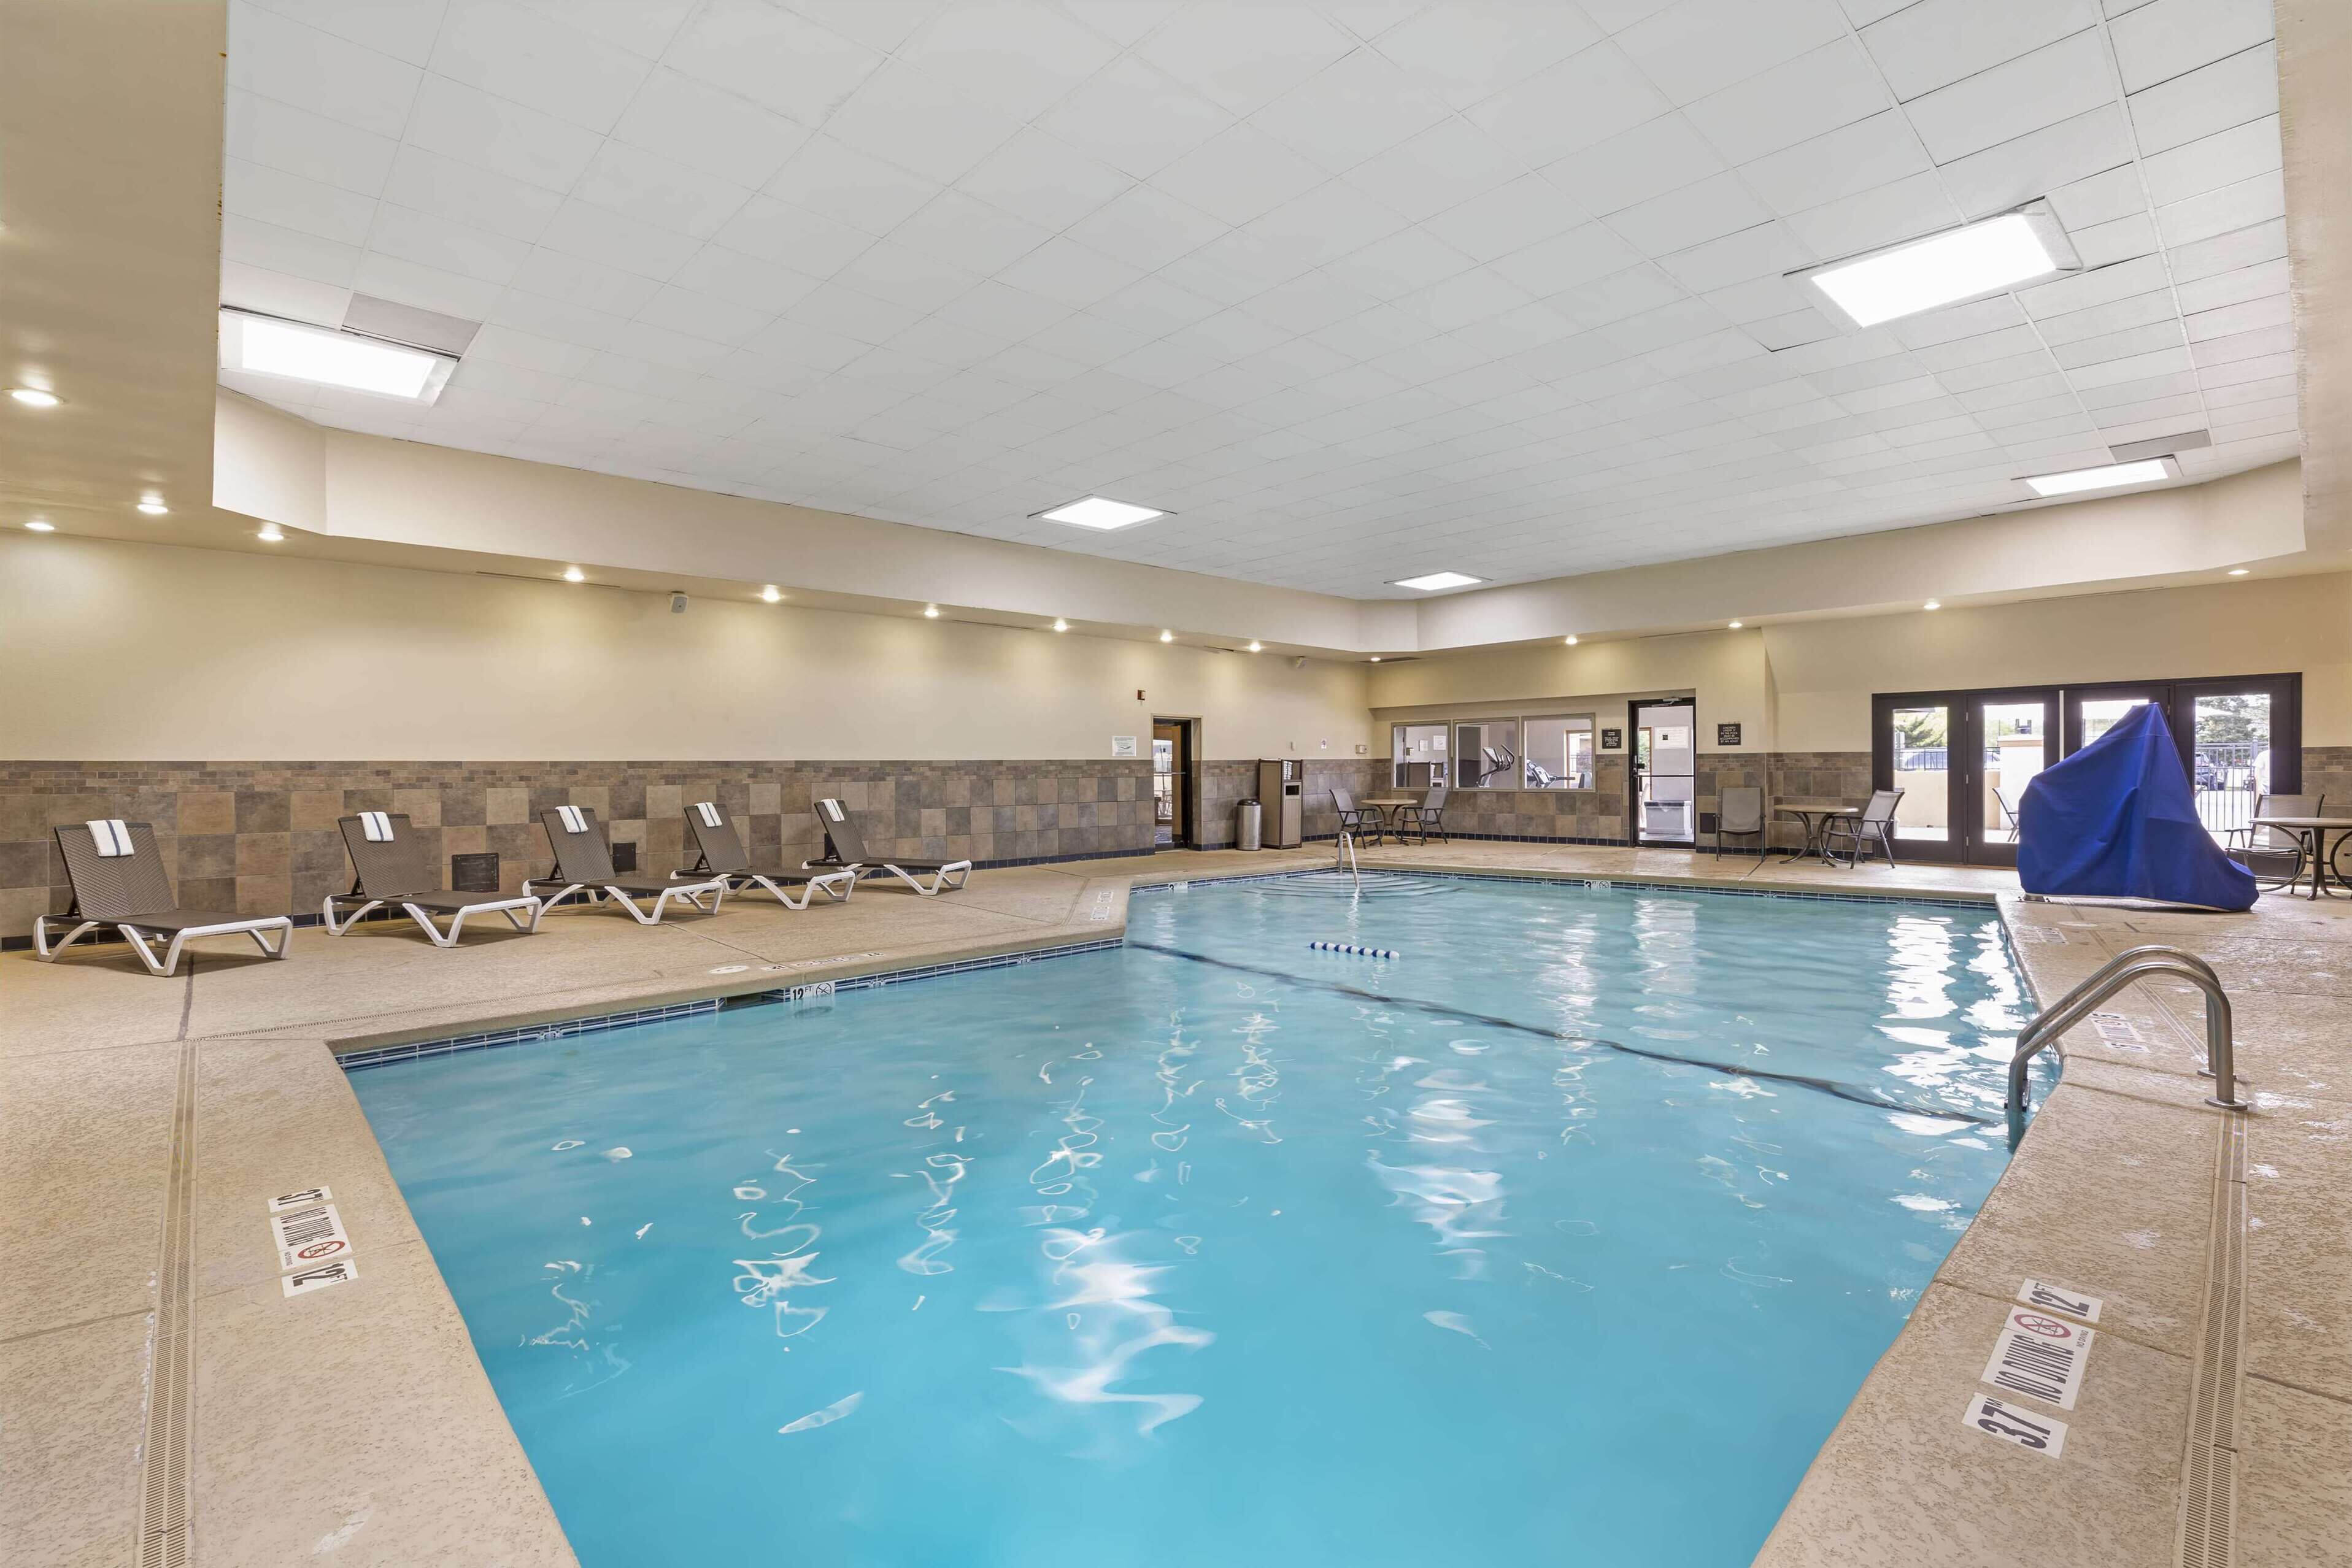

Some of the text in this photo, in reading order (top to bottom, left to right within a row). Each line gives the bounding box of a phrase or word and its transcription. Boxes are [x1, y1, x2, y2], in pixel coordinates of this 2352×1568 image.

[792, 988, 804, 1000] 12
[280, 1207, 336, 1247] NO DIVING
[1994, 1334, 2075, 1404] NO DIVING
